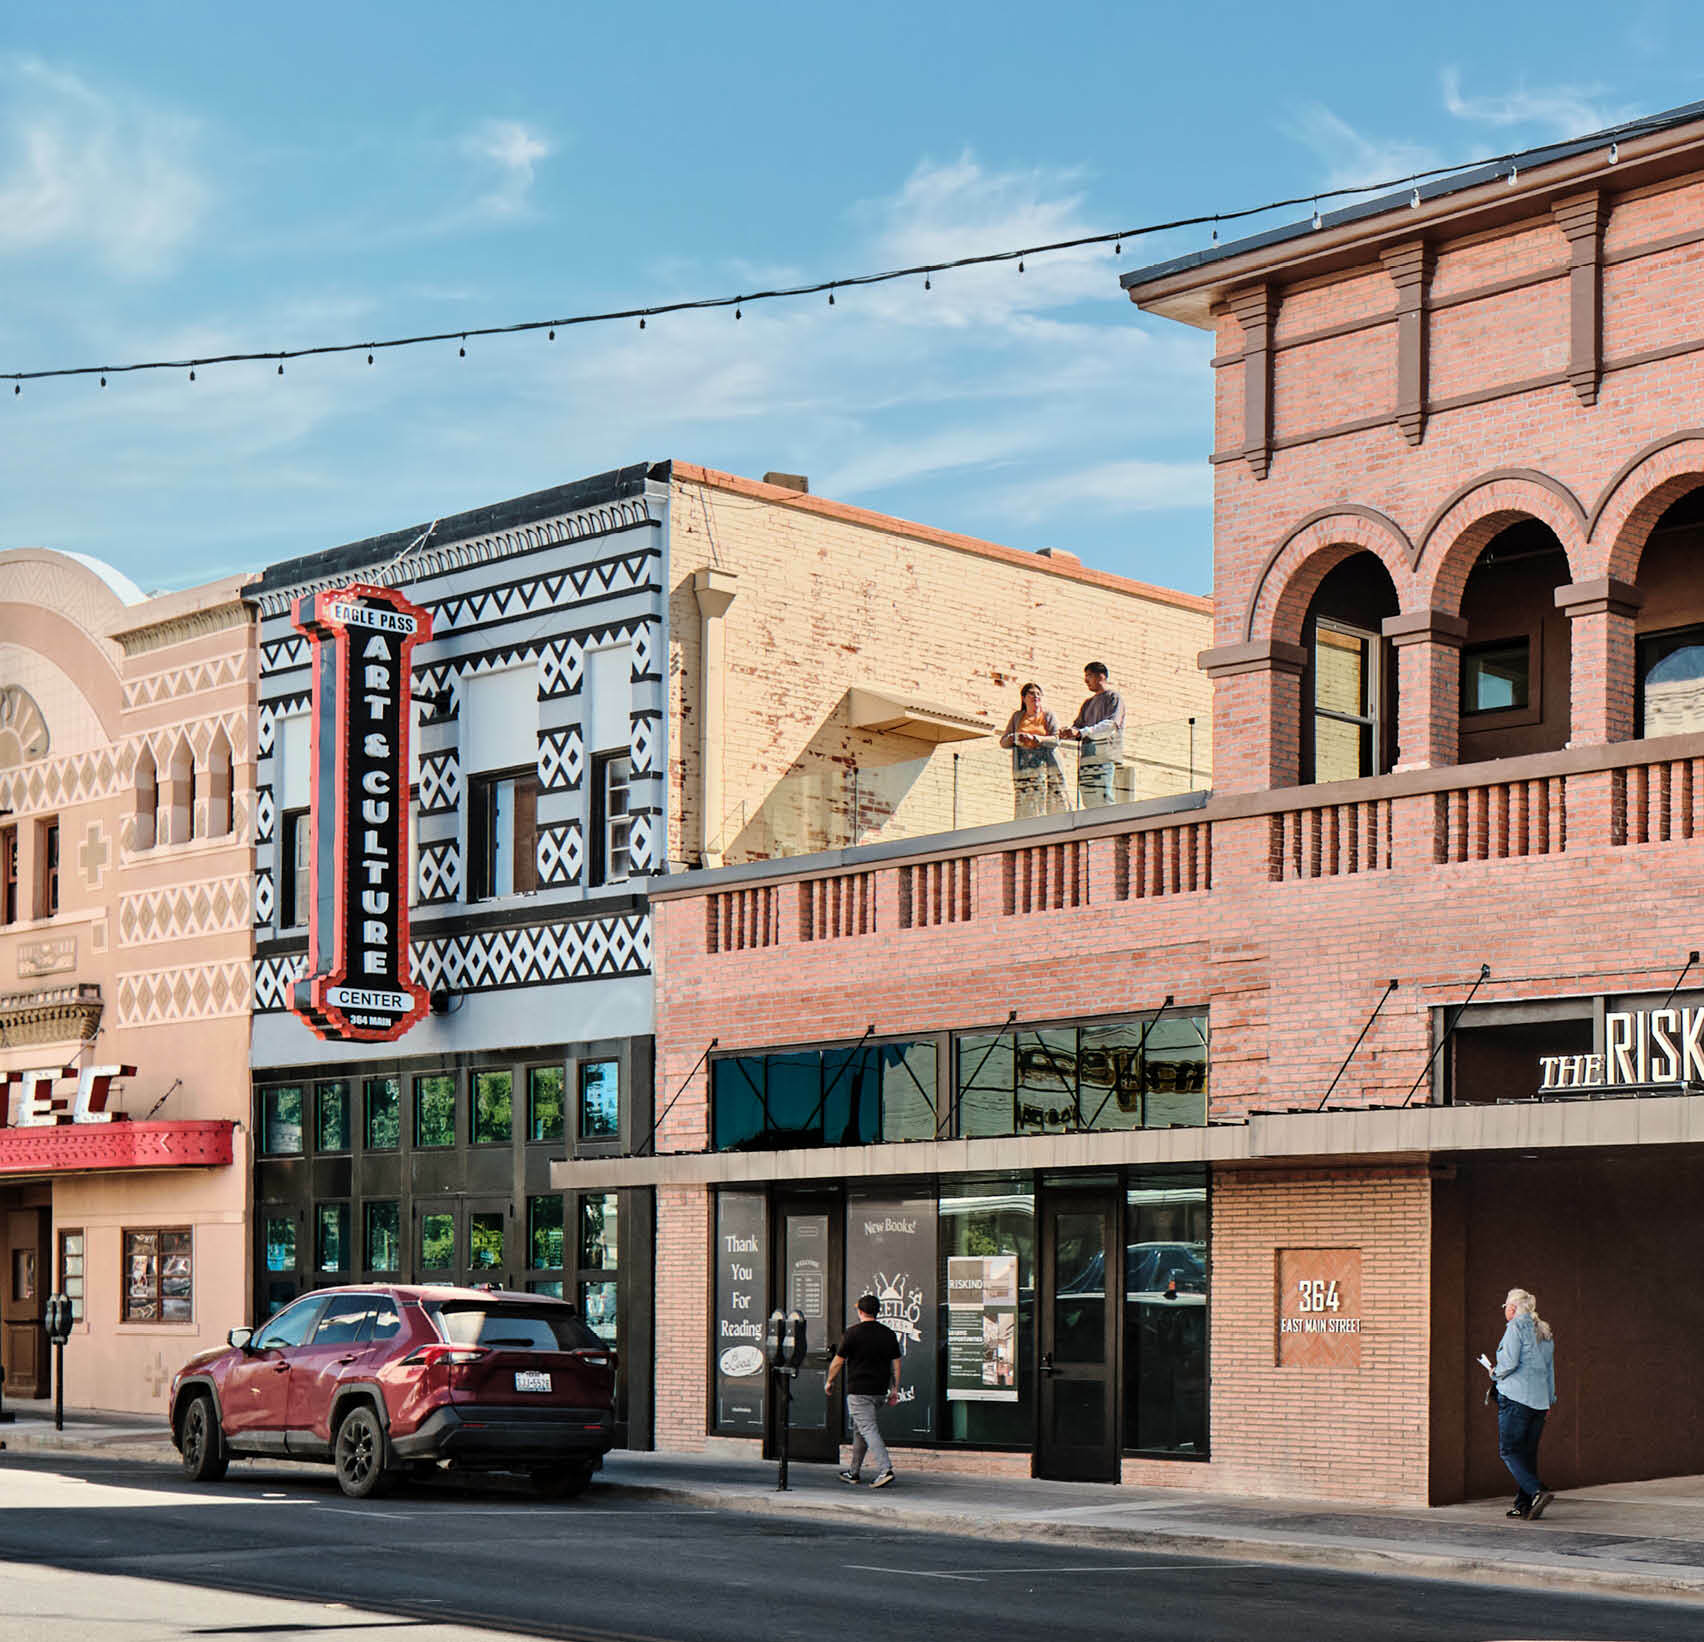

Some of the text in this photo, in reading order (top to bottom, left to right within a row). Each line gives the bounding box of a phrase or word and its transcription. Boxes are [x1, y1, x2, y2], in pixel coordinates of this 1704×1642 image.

[334, 604, 413, 632] EAGLE PASS
[362, 634, 392, 720] ART
[361, 770, 391, 975] CULTURE
[339, 991, 402, 1008] CENTER
[350, 1015, 368, 1025] 364
[1539, 1053, 1605, 1089] THE
[864, 1217, 916, 1236] New Books!
[724, 1234, 759, 1253] Thank
[731, 1263, 753, 1281] You
[949, 1279, 983, 1289] RISKIND
[732, 1292, 752, 1309] For
[1298, 1279, 1340, 1313] 364
[721, 1320, 763, 1341] Reading
[1281, 1318, 1361, 1334] EAST MAIN STREET
